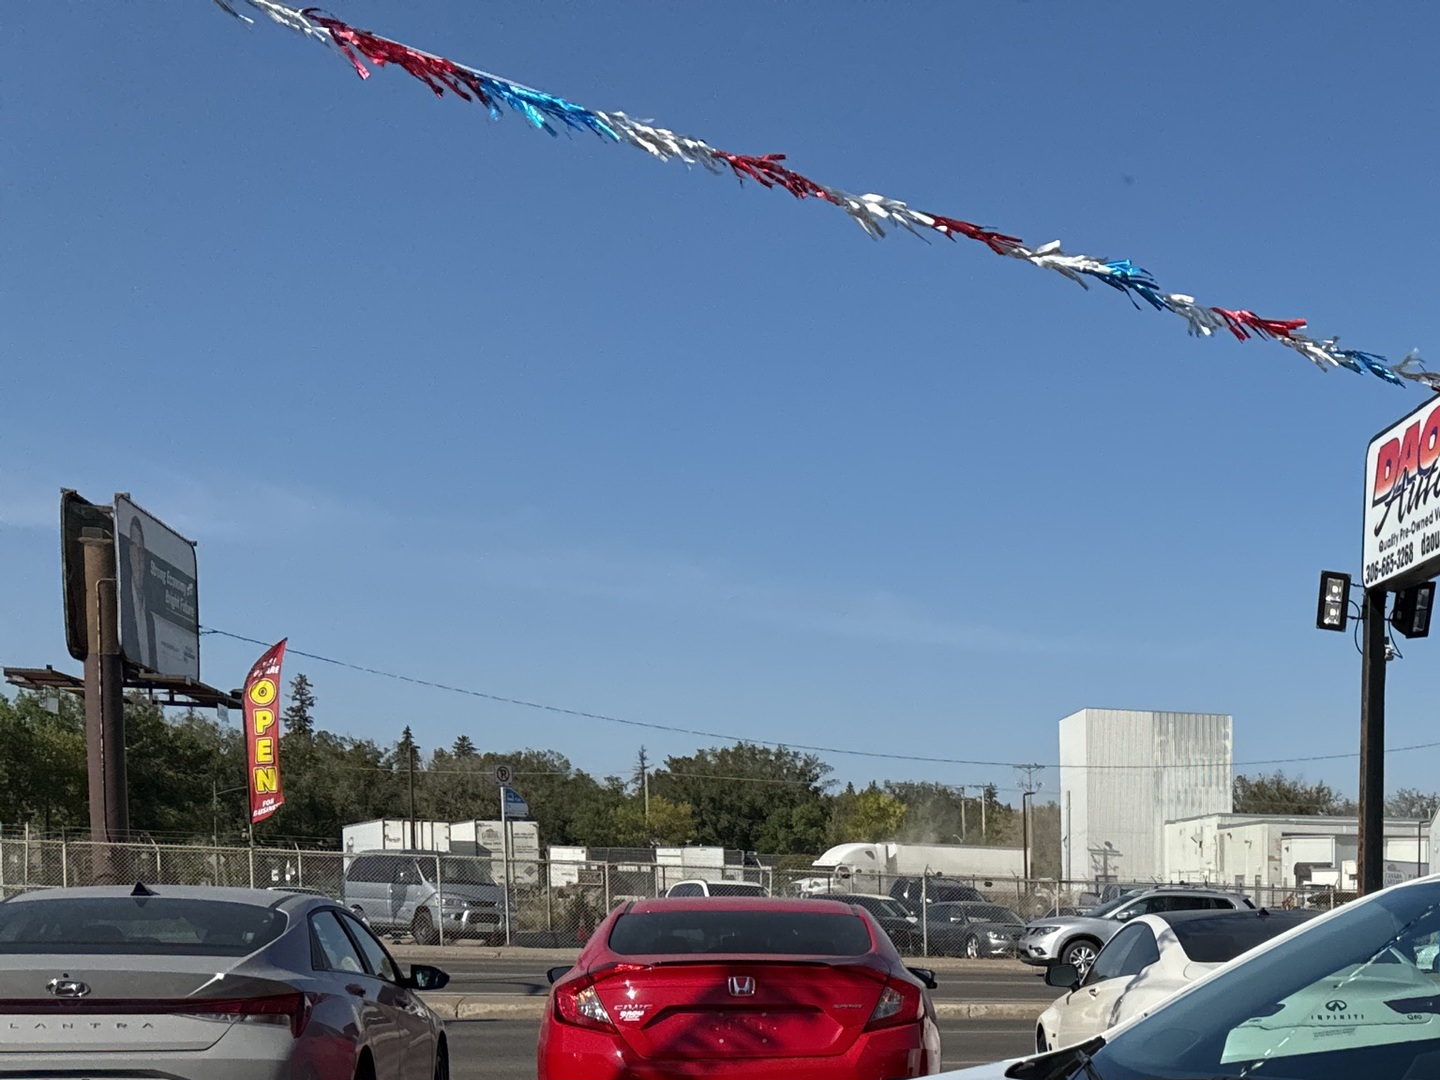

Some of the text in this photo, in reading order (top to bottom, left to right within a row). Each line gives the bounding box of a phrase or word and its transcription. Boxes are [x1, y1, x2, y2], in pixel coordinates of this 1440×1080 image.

[1379, 532, 1399, 553] Quality
[1400, 510, 1433, 538] Pre-Owned
[1365, 541, 1414, 585] 306-665-3268
[150, 560, 167, 586] Strong
[167, 570, 187, 596] Economy
[165, 589, 180, 610] Bright
[180, 598, 194, 617] Future
[248, 677, 278, 794] OPEN
[253, 802, 282, 817] BUSINE
[262, 798, 275, 808] FOR
[613, 1003, 653, 1011] CIVIC
[1310, 1013, 1365, 1021] INFINITI
